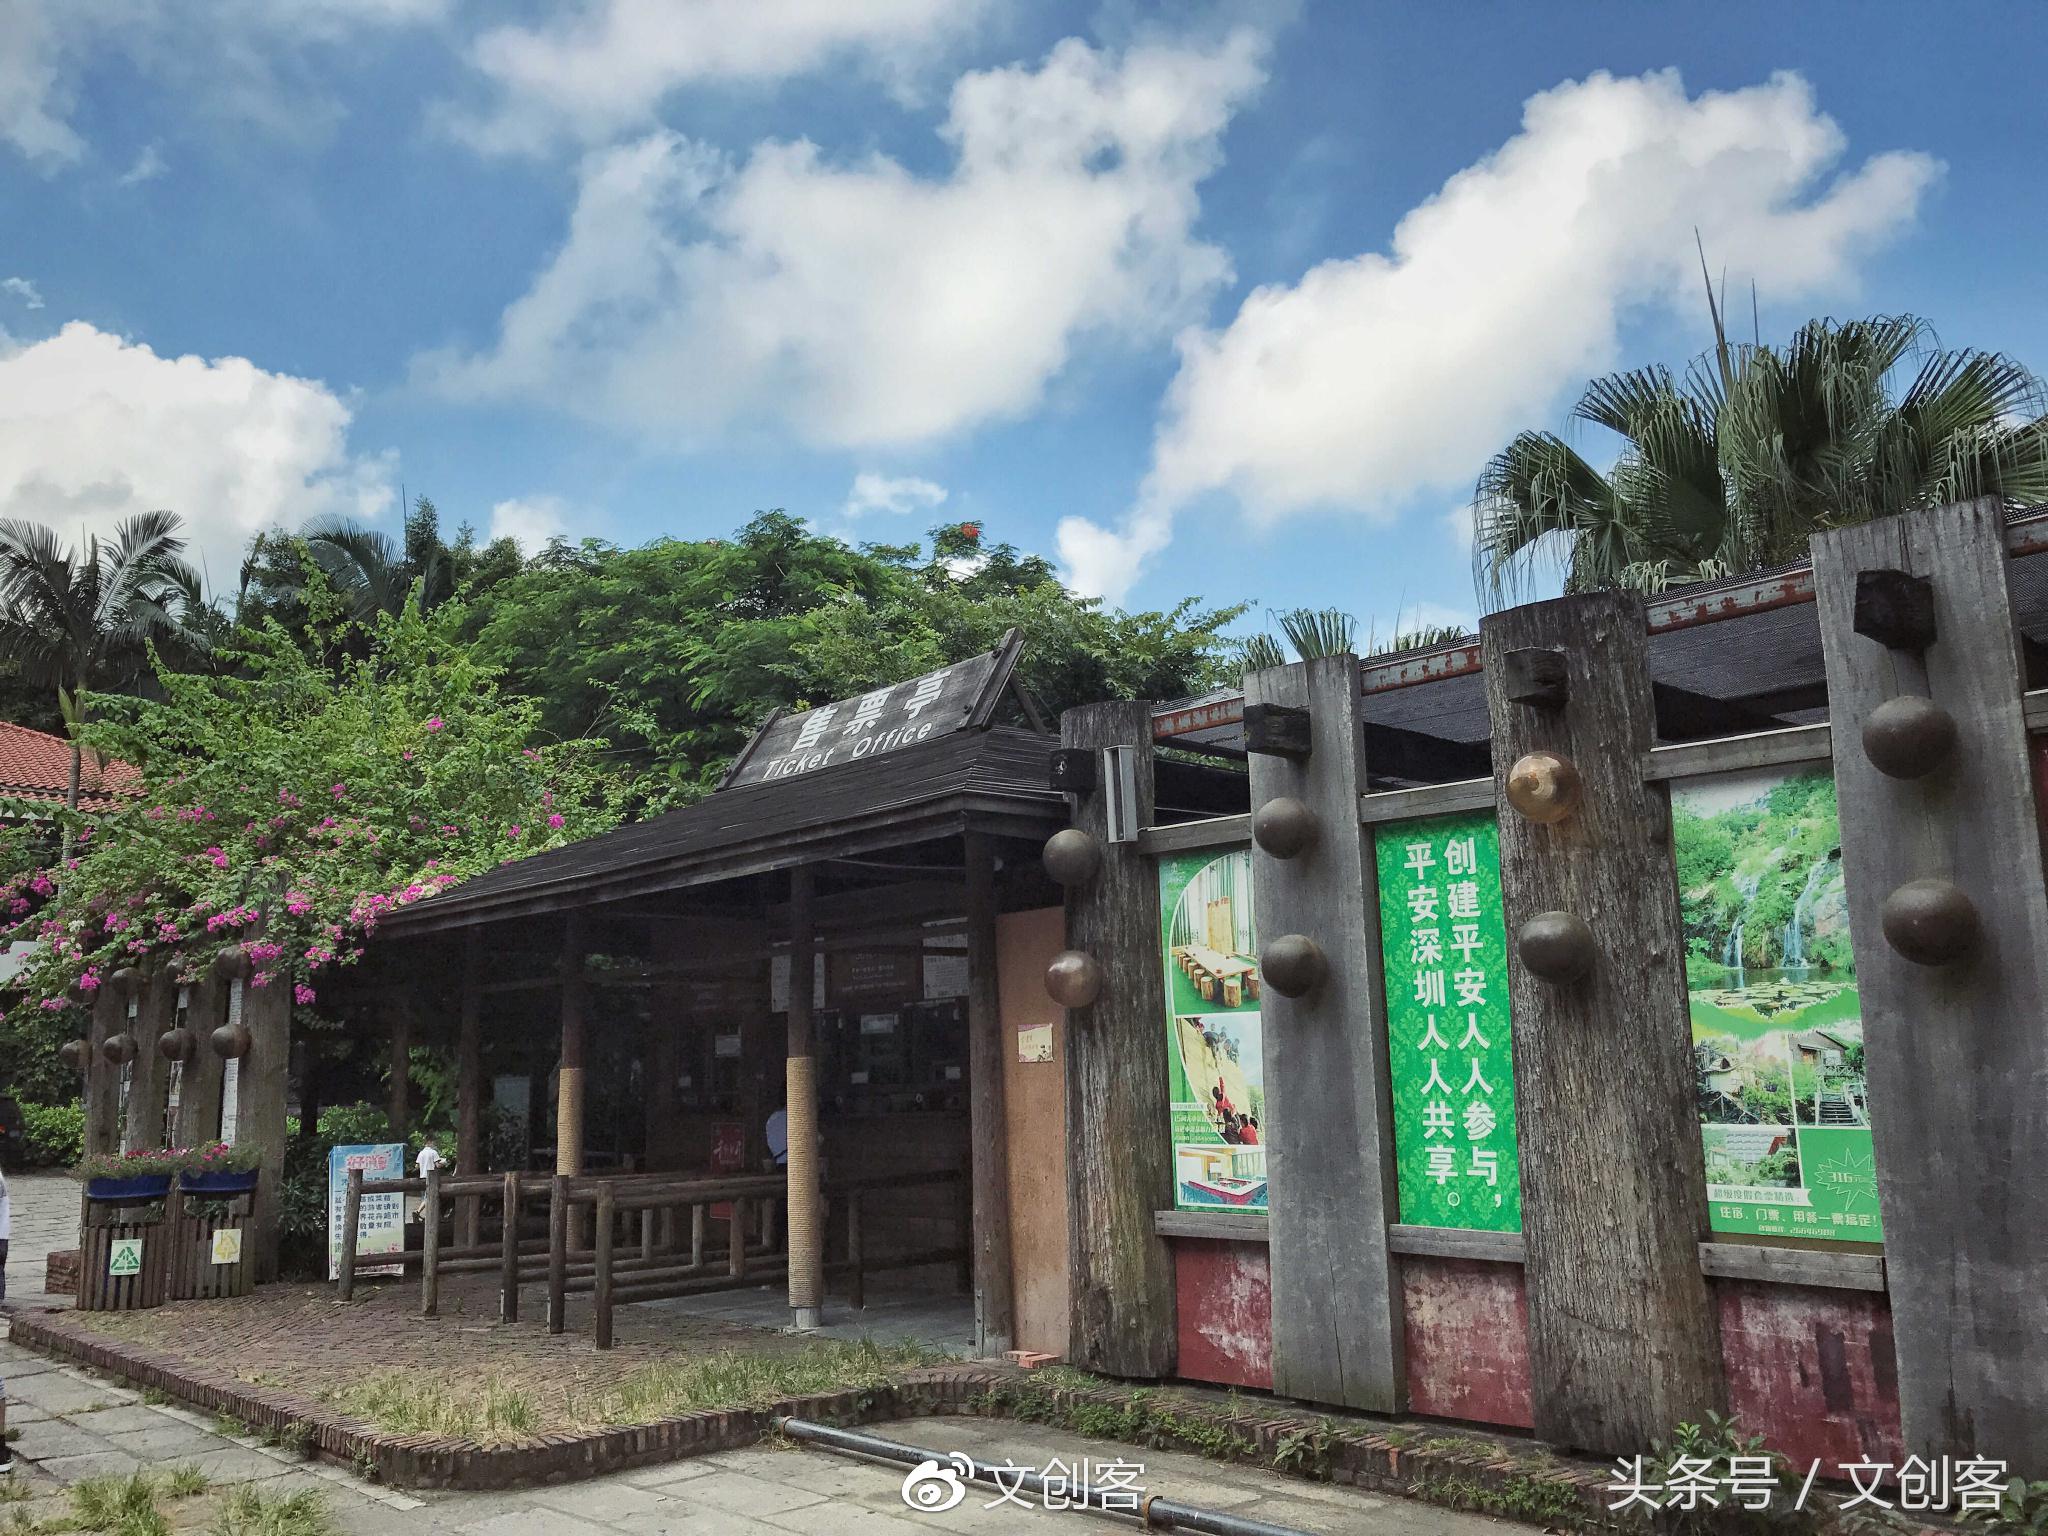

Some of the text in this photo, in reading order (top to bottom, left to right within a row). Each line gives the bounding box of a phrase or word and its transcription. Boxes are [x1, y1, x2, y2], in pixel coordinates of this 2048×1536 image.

[763, 720, 932, 778] Ticket Office
[791, 670, 952, 753] 售票亭
[1403, 842, 1461, 1207] 平安深圳人人共享。
[1443, 837, 1503, 1208] 创建平安人人参与，
